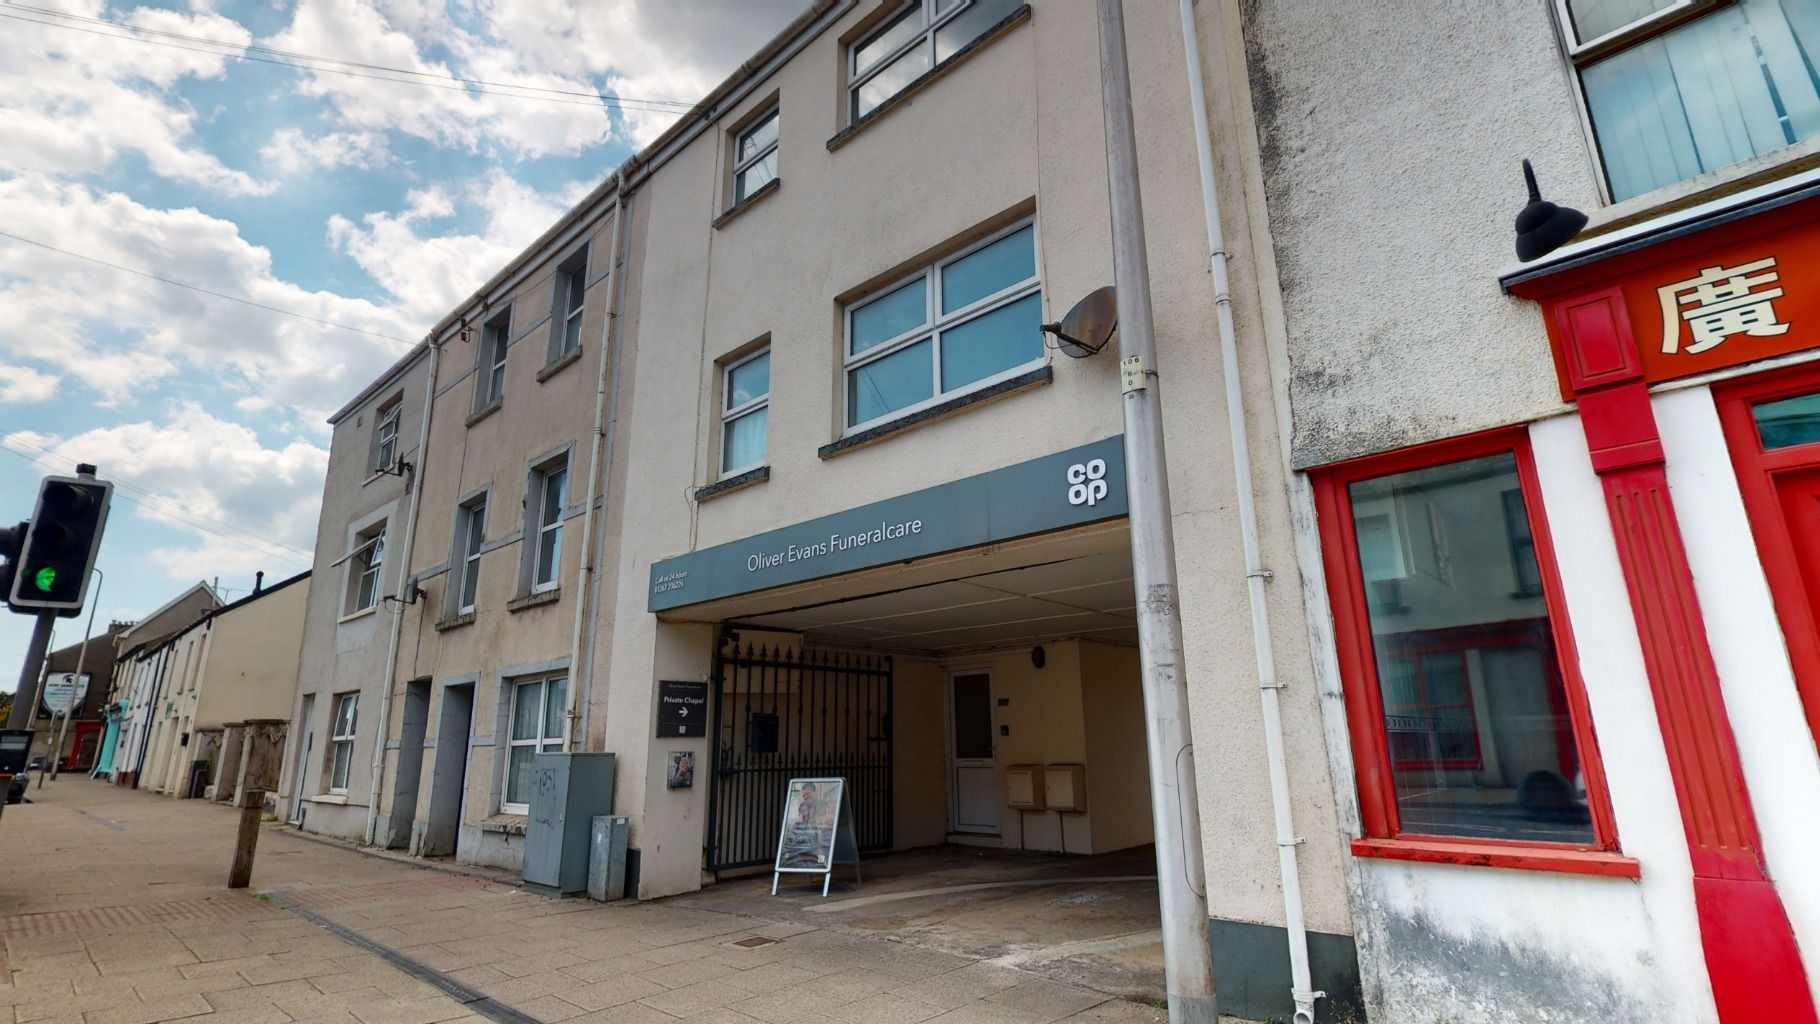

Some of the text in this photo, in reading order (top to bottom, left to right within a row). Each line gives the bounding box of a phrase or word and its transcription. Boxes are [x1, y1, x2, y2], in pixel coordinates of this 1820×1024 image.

[1656, 256, 1792, 355] 廣
[747, 519, 923, 572] Oliver Evans Funeralcare
[655, 575, 664, 584] Call
[663, 695, 705, 706] Private Chapel
